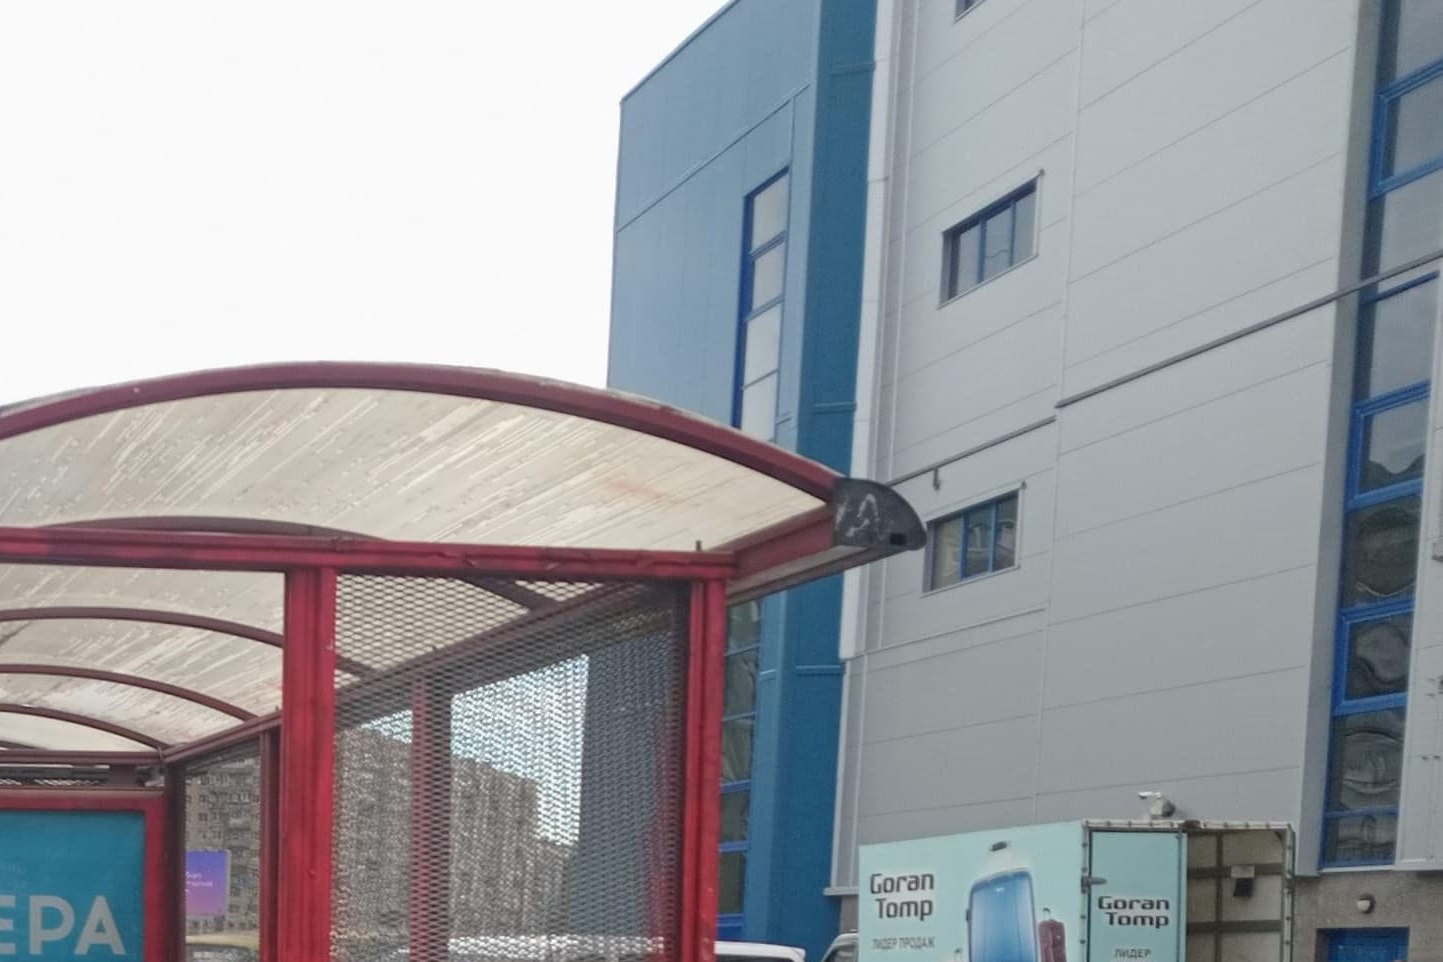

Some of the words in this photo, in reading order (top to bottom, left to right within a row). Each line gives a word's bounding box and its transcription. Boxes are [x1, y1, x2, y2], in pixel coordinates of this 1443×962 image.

[870, 873, 934, 894] Goran
[875, 898, 933, 921] Tomp
[1098, 895, 1170, 910] Goran
[1105, 911, 1170, 929] Tomp
[1115, 948, 1151, 959] ЛИДЕР
